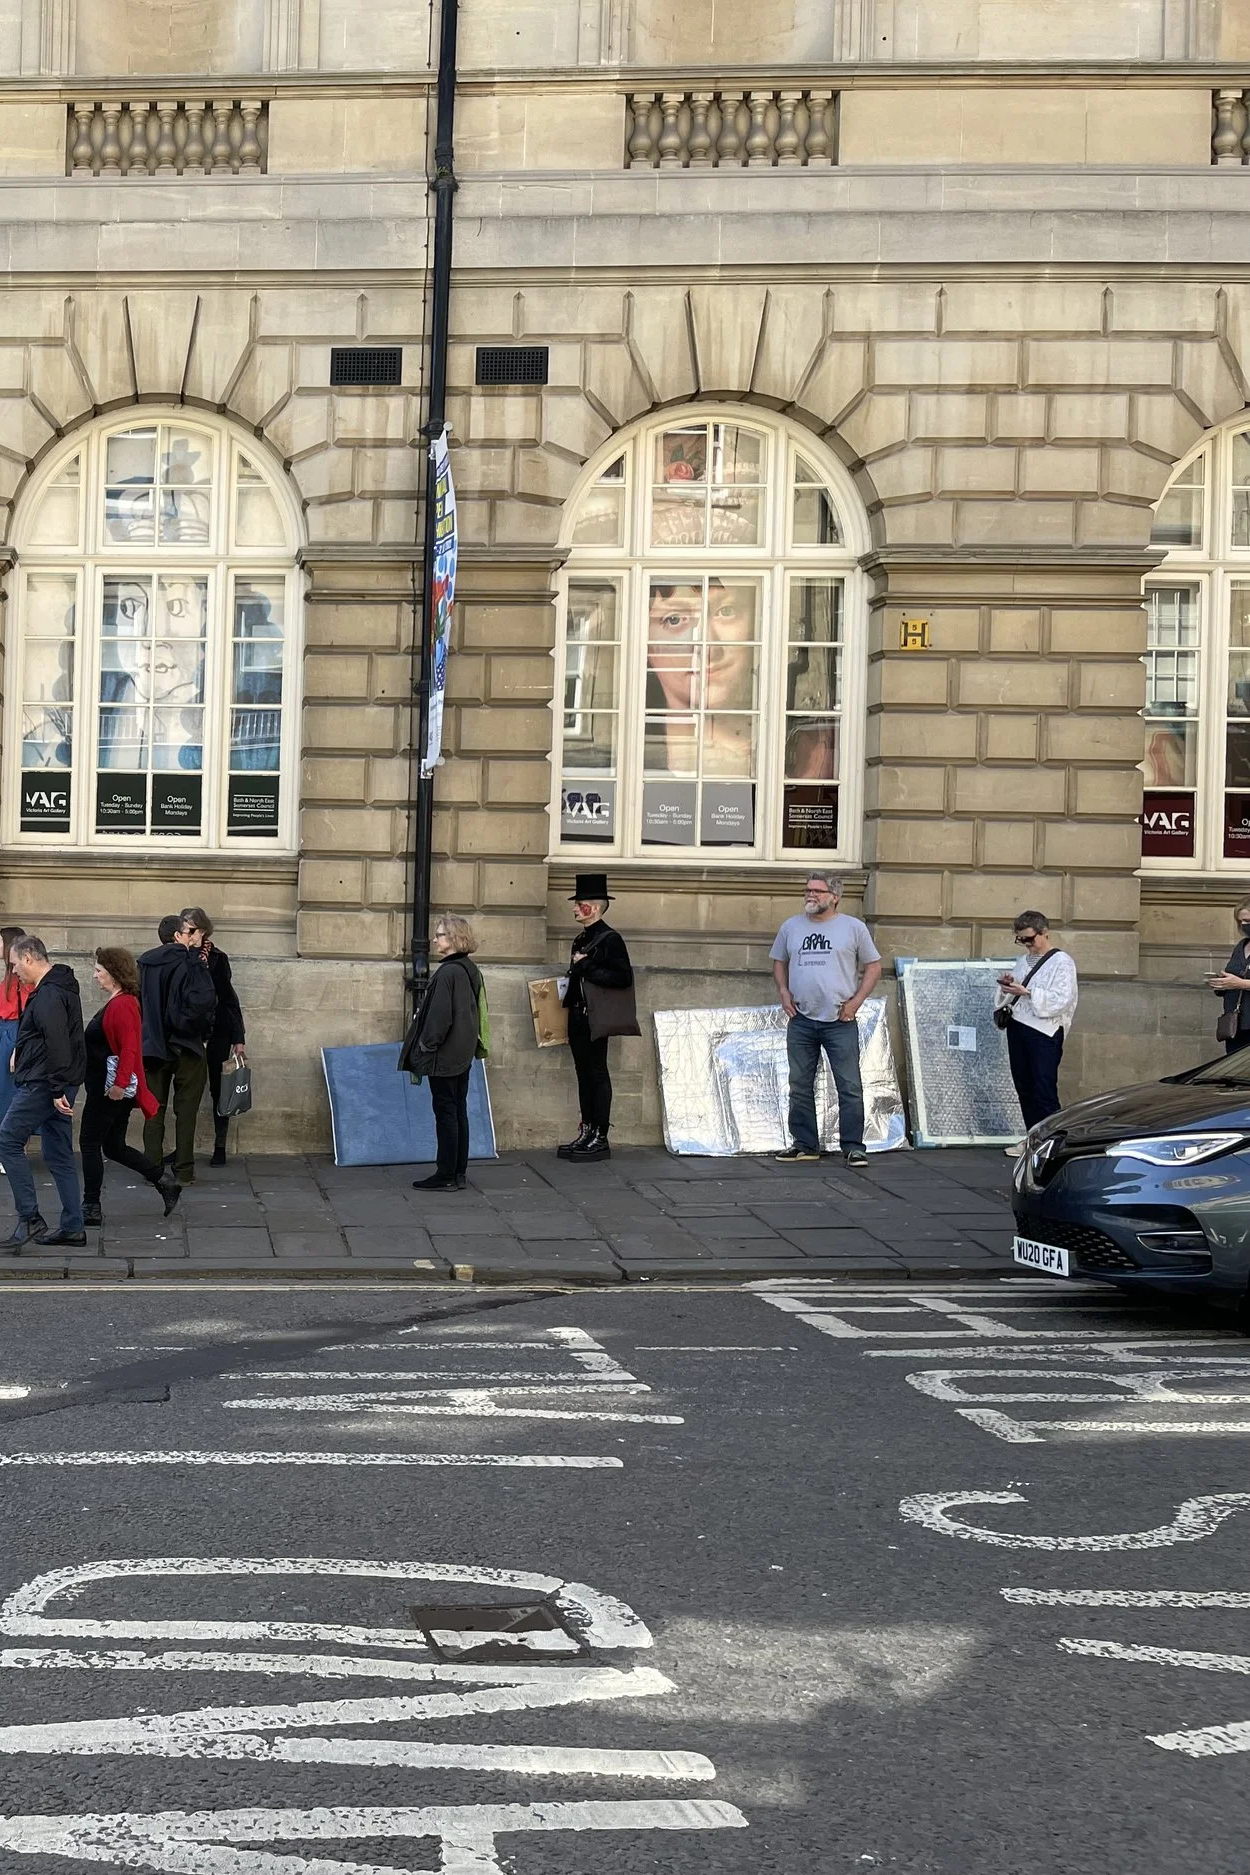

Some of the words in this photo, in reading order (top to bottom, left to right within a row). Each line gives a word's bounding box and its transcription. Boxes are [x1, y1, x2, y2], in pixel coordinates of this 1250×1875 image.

[26, 791, 67, 808] VAG
[112, 794, 132, 803] Open
[166, 795, 187, 804] Open
[566, 802, 610, 819] VAG
[659, 804, 680, 812] Open
[718, 805, 739, 814] Open
[646, 811, 669, 819] Tuesday
[672, 812, 693, 820] Sunday
[1144, 812, 1190, 830] VAG
[1016, 1239, 1040, 1264] WU20
[1042, 1247, 1064, 1271] GFA
[217, 1326, 684, 1426] ALL
